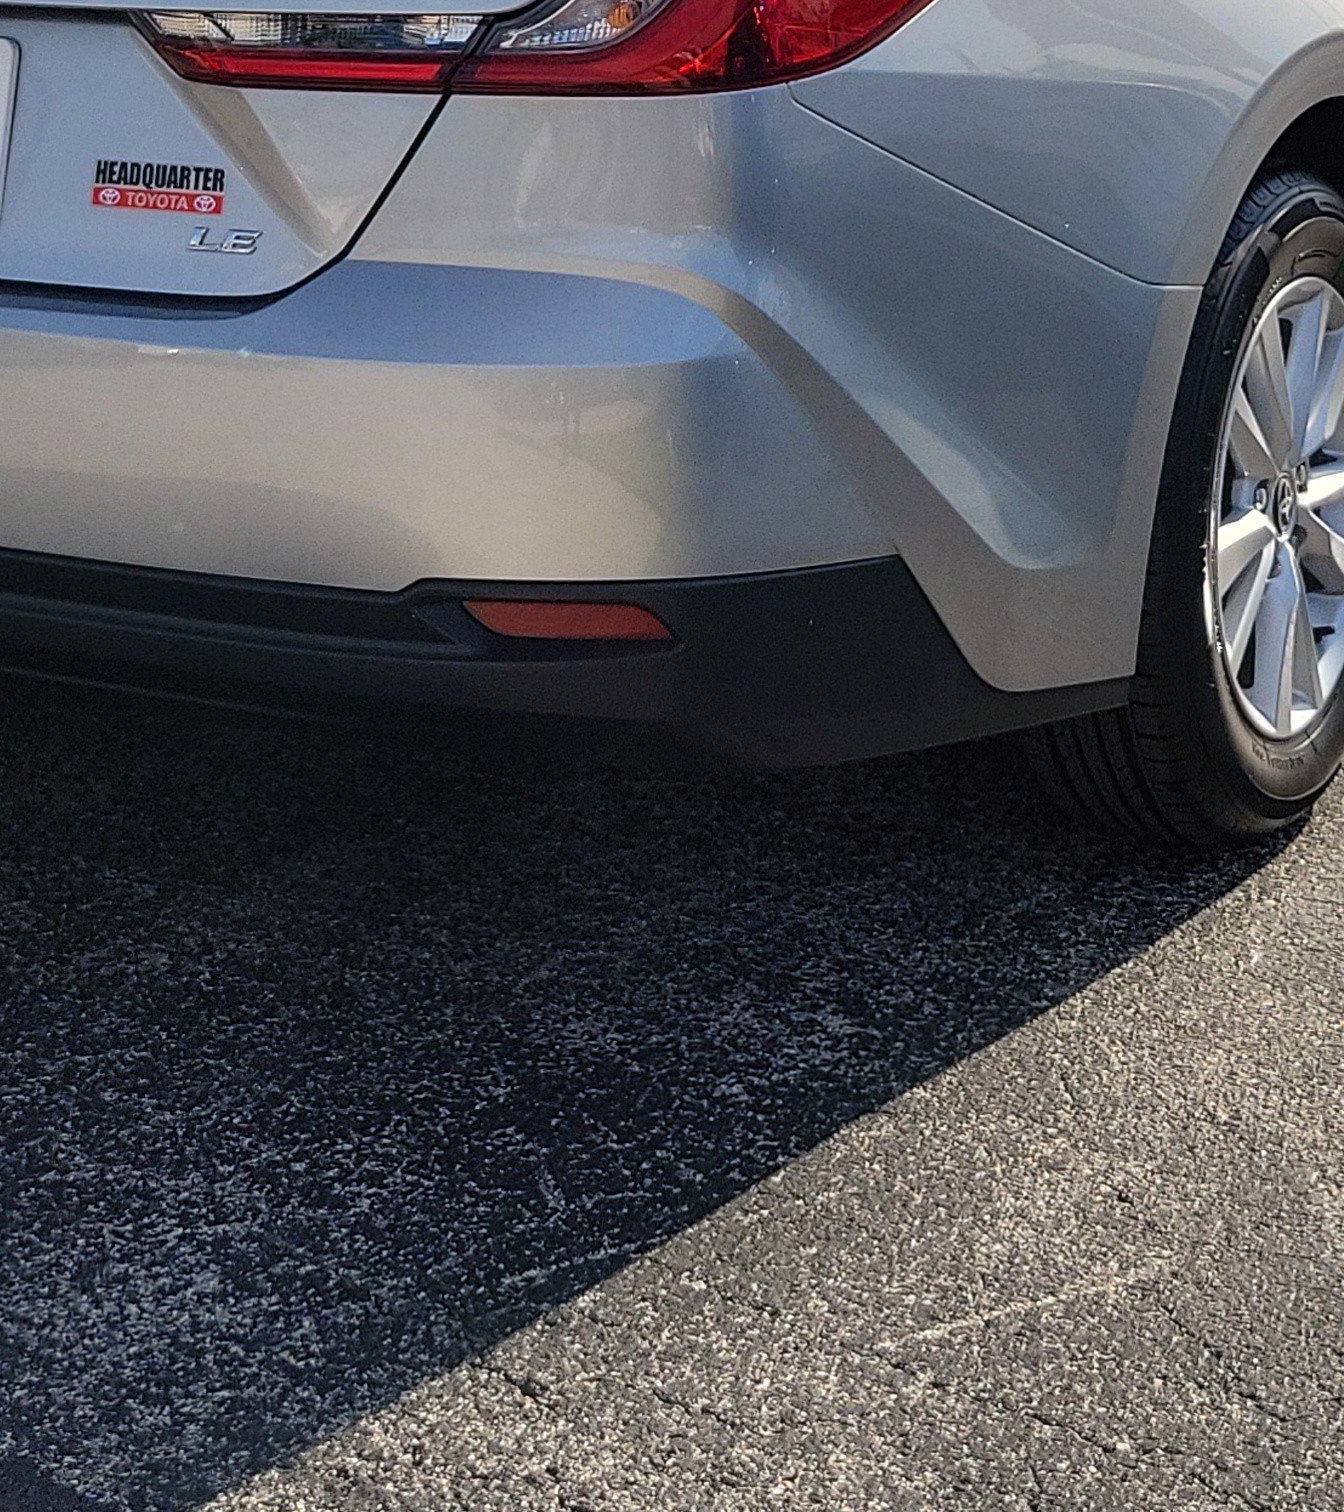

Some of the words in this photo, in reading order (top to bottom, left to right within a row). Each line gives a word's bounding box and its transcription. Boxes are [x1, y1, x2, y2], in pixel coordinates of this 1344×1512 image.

[95, 159, 225, 193] HEADQUARTER
[125, 191, 188, 210] TOYOTA
[186, 225, 264, 255] LE
